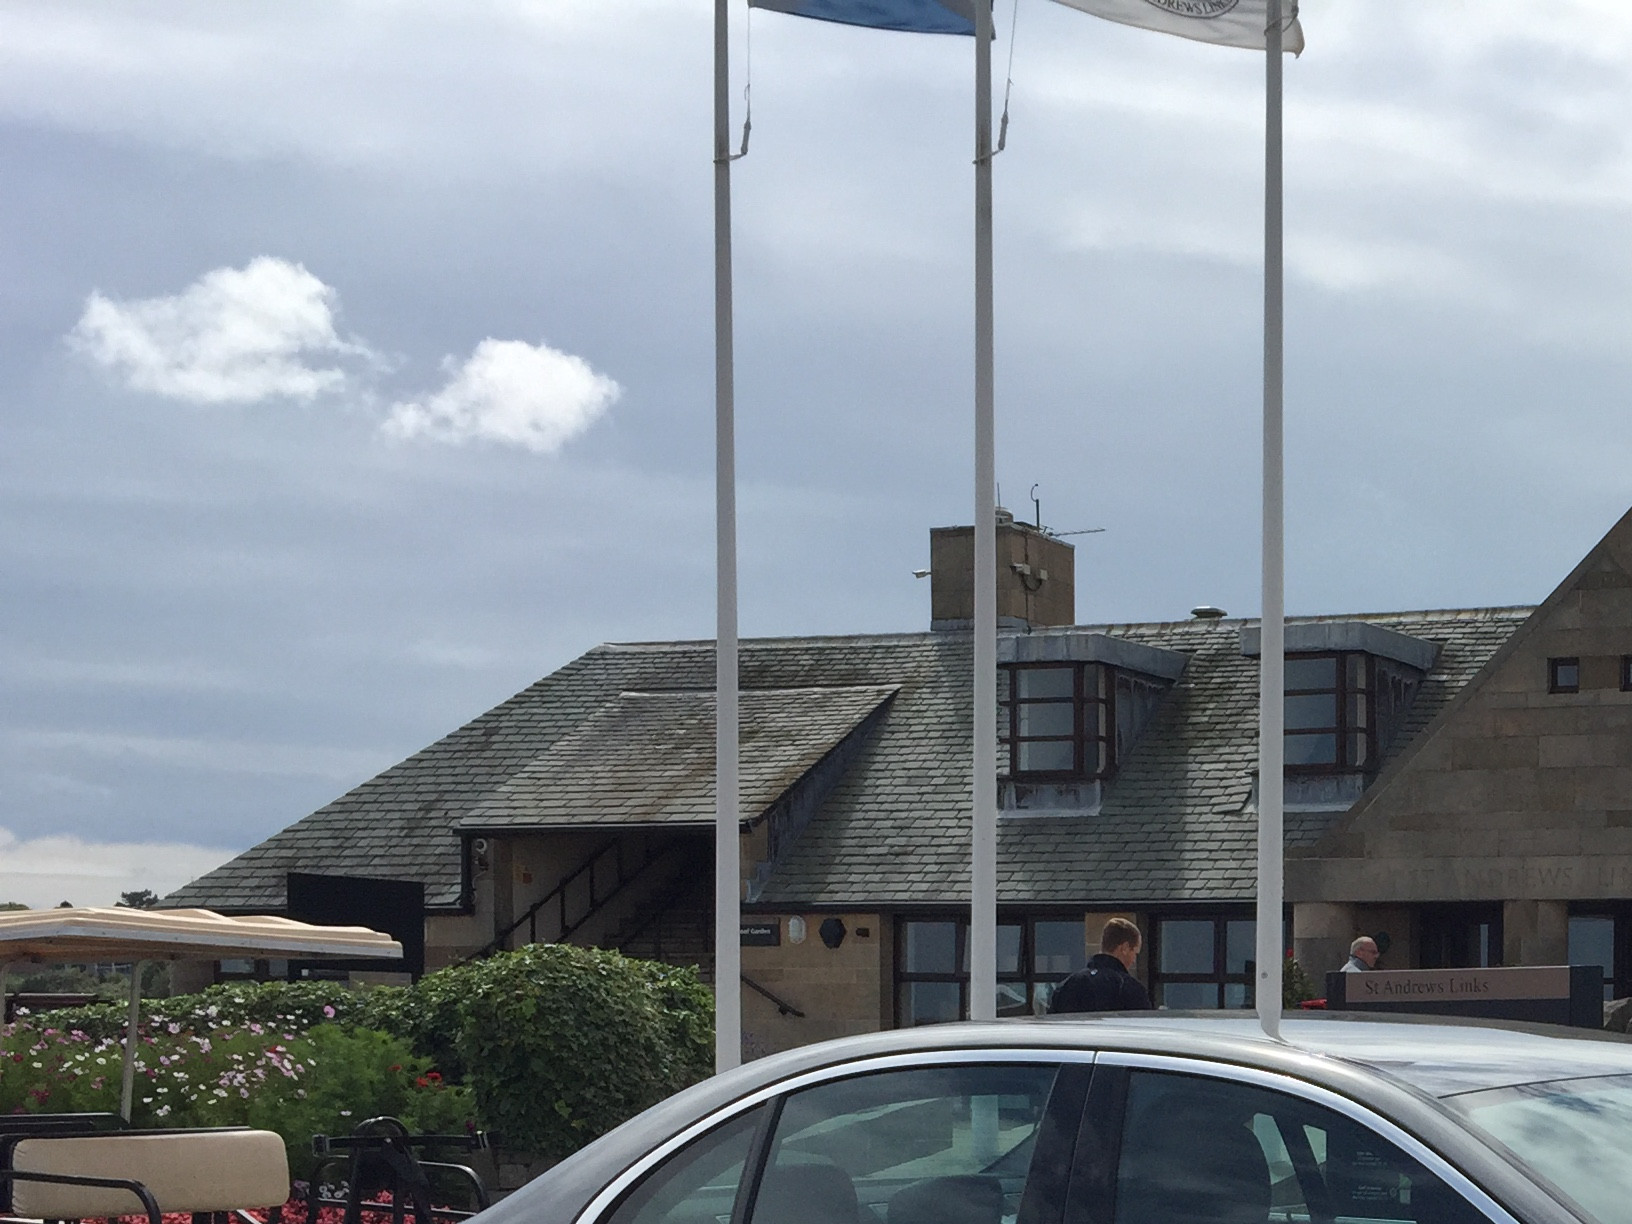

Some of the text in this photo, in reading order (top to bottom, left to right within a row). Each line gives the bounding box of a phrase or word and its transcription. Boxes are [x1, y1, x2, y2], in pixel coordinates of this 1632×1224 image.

[1364, 977, 1489, 995] St Andrews Links
